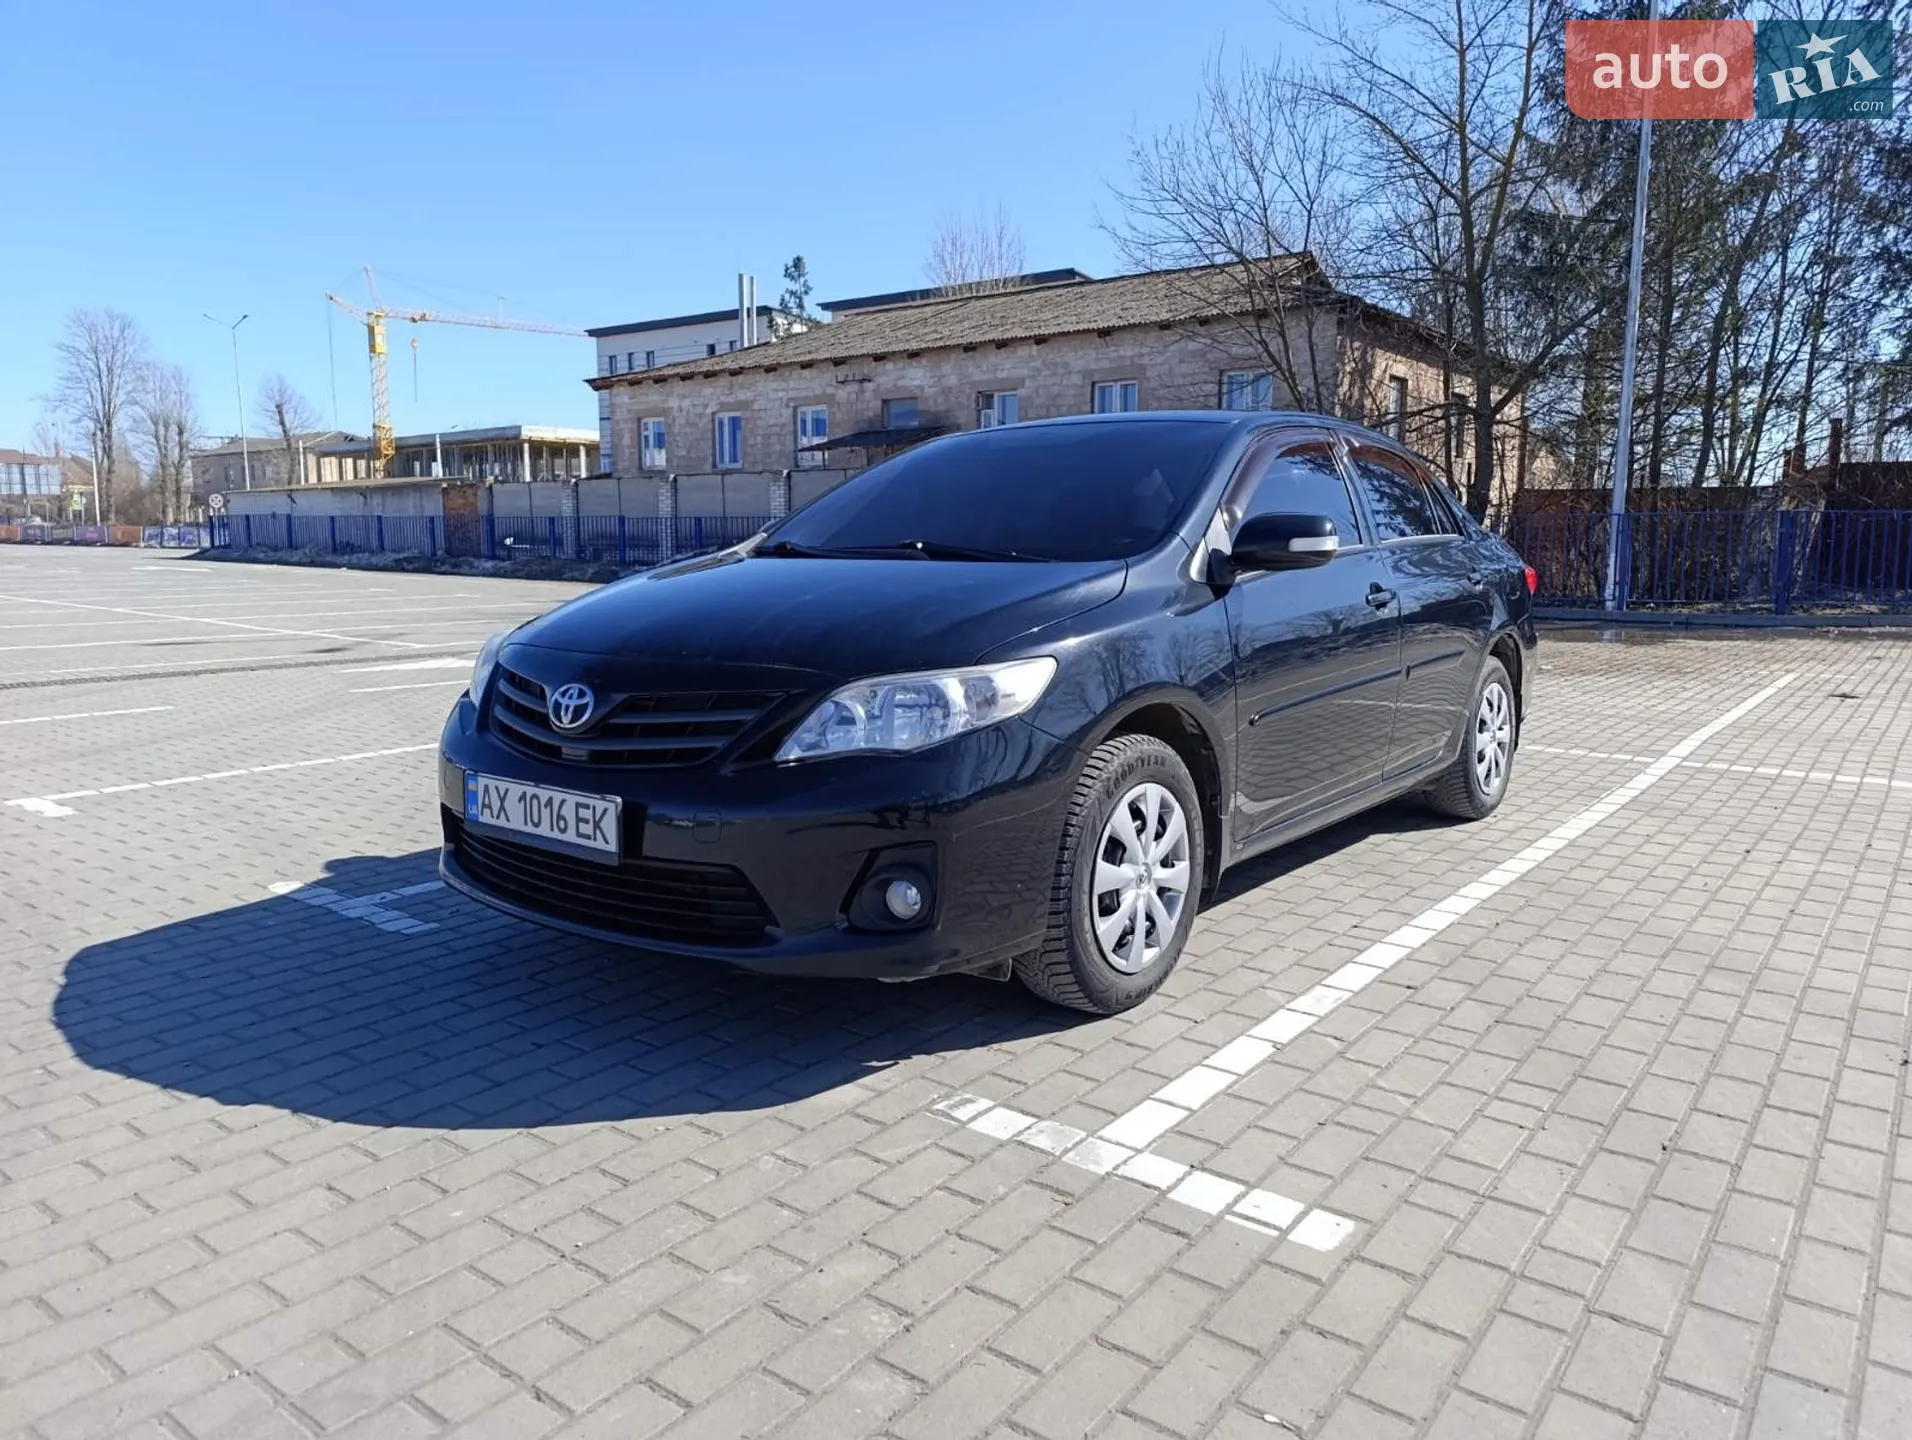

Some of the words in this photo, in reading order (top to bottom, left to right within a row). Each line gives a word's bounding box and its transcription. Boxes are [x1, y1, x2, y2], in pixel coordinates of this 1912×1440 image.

[480, 783, 511, 823] AX
[518, 790, 568, 835] 1016
[575, 801, 610, 846] EK
